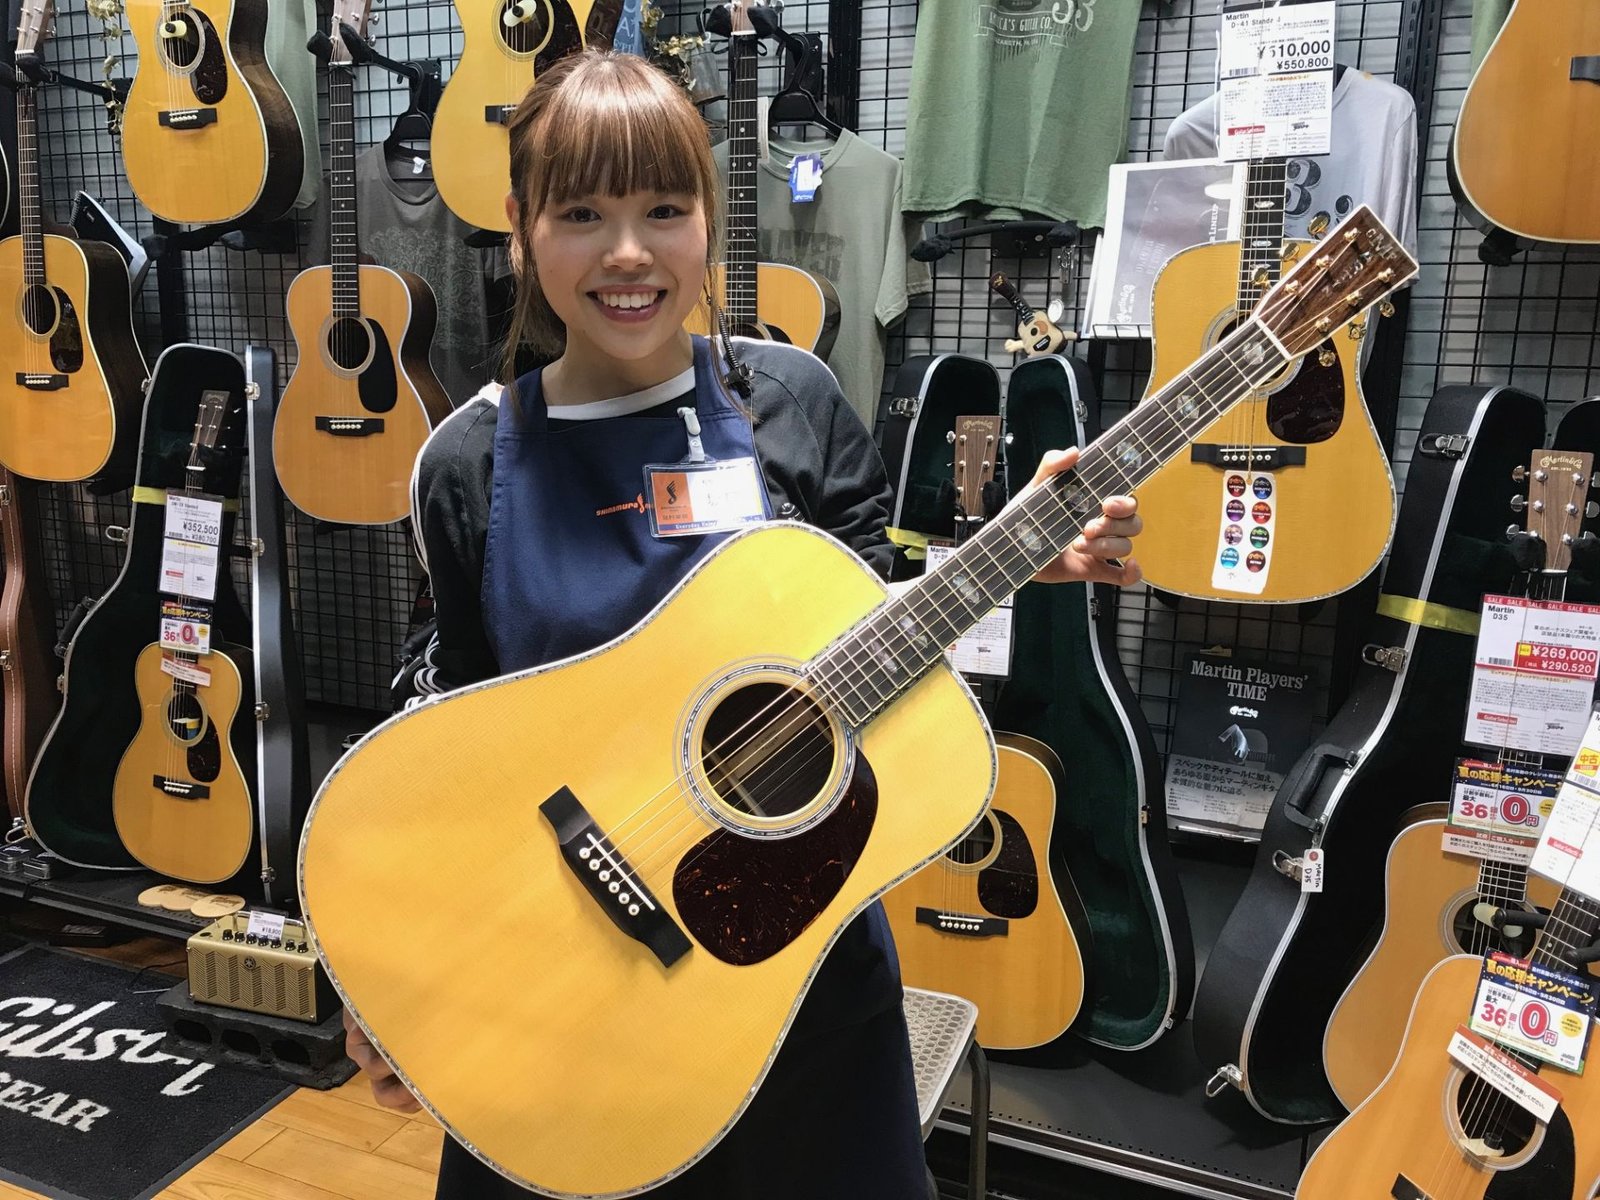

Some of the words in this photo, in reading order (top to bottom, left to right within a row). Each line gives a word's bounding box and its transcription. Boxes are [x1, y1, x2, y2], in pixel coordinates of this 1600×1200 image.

[1225, 12, 1249, 21] Martin
[1231, 20, 1249, 29] D-41
[183, 521, 219, 536] ¥352,500
[675, 521, 701, 530] Everyday
[930, 546, 949, 554] Martin
[1507, 598, 1523, 606] SALE
[1488, 605, 1515, 614] Martin
[1492, 613, 1508, 621] D35
[164, 630, 176, 642] 36
[1532, 645, 1596, 662] ¥269,000
[1191, 660, 1242, 680] Martin
[1227, 682, 1268, 701] TIME
[1580, 754, 1599, 764] 中古
[1460, 801, 1488, 819] 36
[1501, 794, 1530, 824] 0
[1526, 815, 1539, 826] 円
[1480, 1003, 1508, 1027] 36
[1520, 1000, 1551, 1040] 0
[1545, 1029, 1559, 1047] 円
